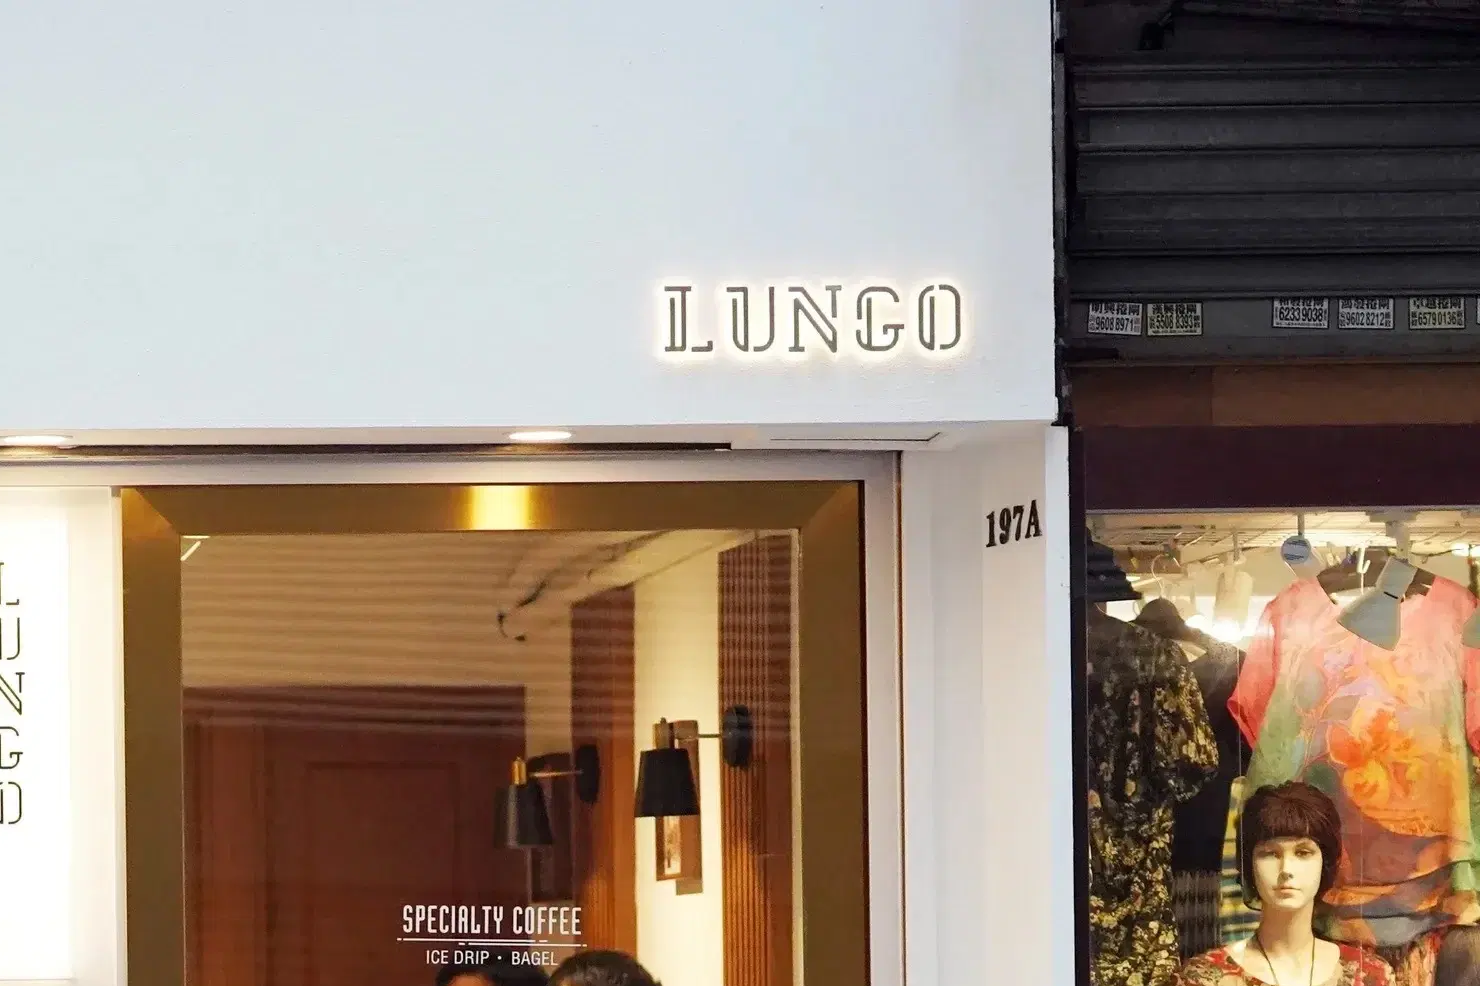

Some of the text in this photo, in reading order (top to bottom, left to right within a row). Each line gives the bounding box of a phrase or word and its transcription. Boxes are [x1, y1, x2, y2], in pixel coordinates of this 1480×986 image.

[664, 284, 962, 353] LUNGO
[1279, 307, 1323, 321] 6233 9038
[1346, 311, 1385, 326] 9602 8212
[1095, 316, 1134, 331] 9608 8971
[985, 499, 1043, 548] 197A
[402, 904, 582, 935] SPECIALTY COFFEE
[426, 950, 558, 966] ICE DRIP BAGEL
